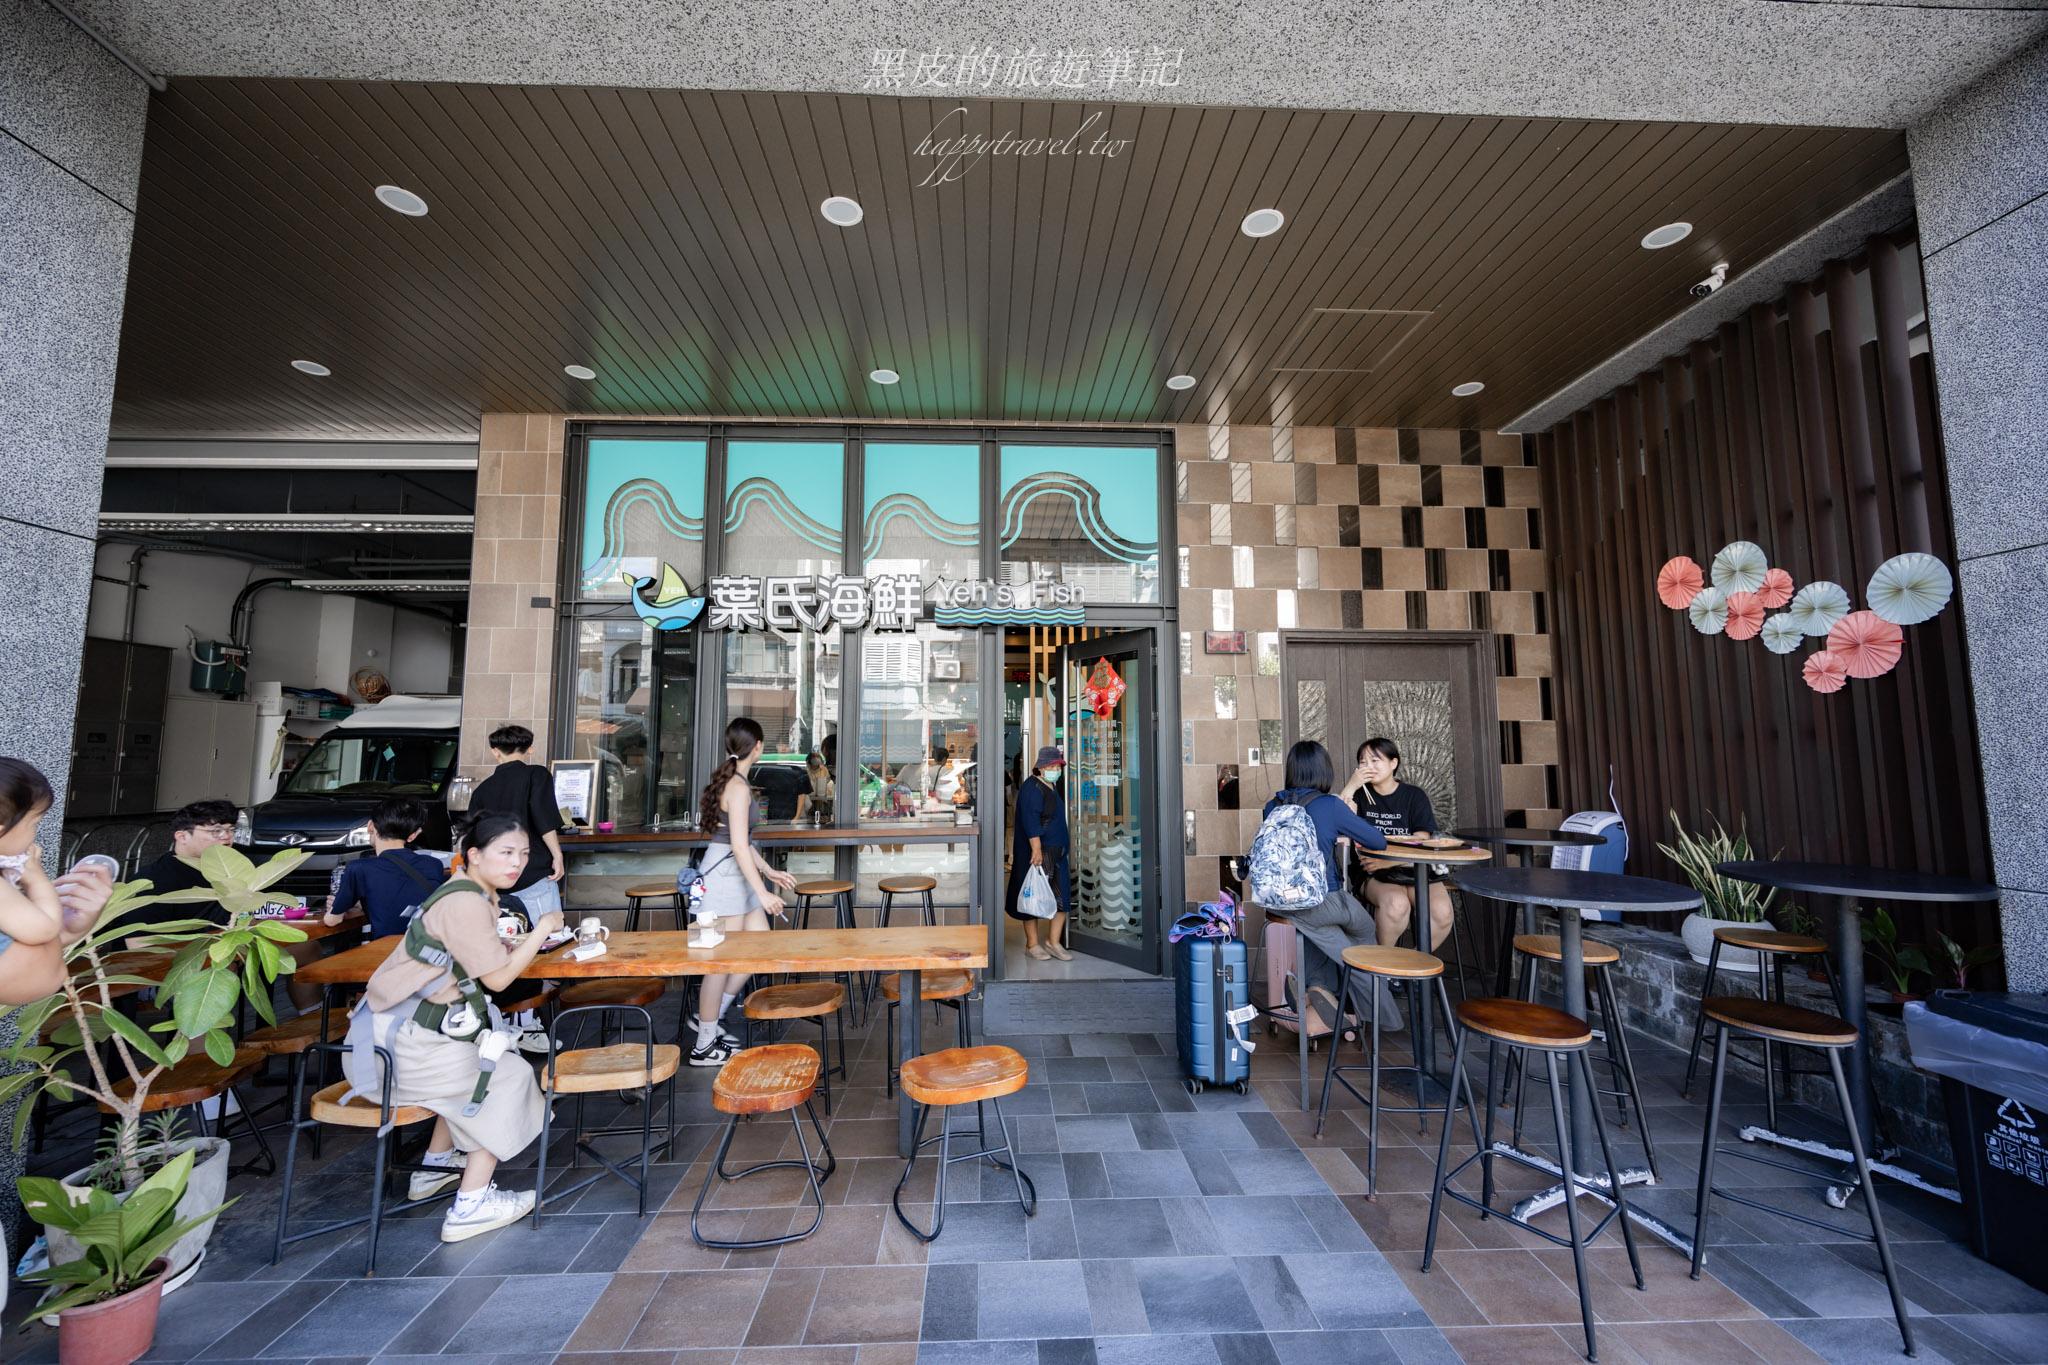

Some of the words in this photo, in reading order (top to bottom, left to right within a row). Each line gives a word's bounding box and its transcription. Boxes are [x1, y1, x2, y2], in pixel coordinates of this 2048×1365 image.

[709, 574, 924, 630] 葉氏海鮮
[937, 577, 1011, 603] Yeh's
[1032, 580, 1085, 603] Fish
[1992, 1129, 2022, 1145] Residual
[1998, 1123, 2041, 1145] 其他垃圾
